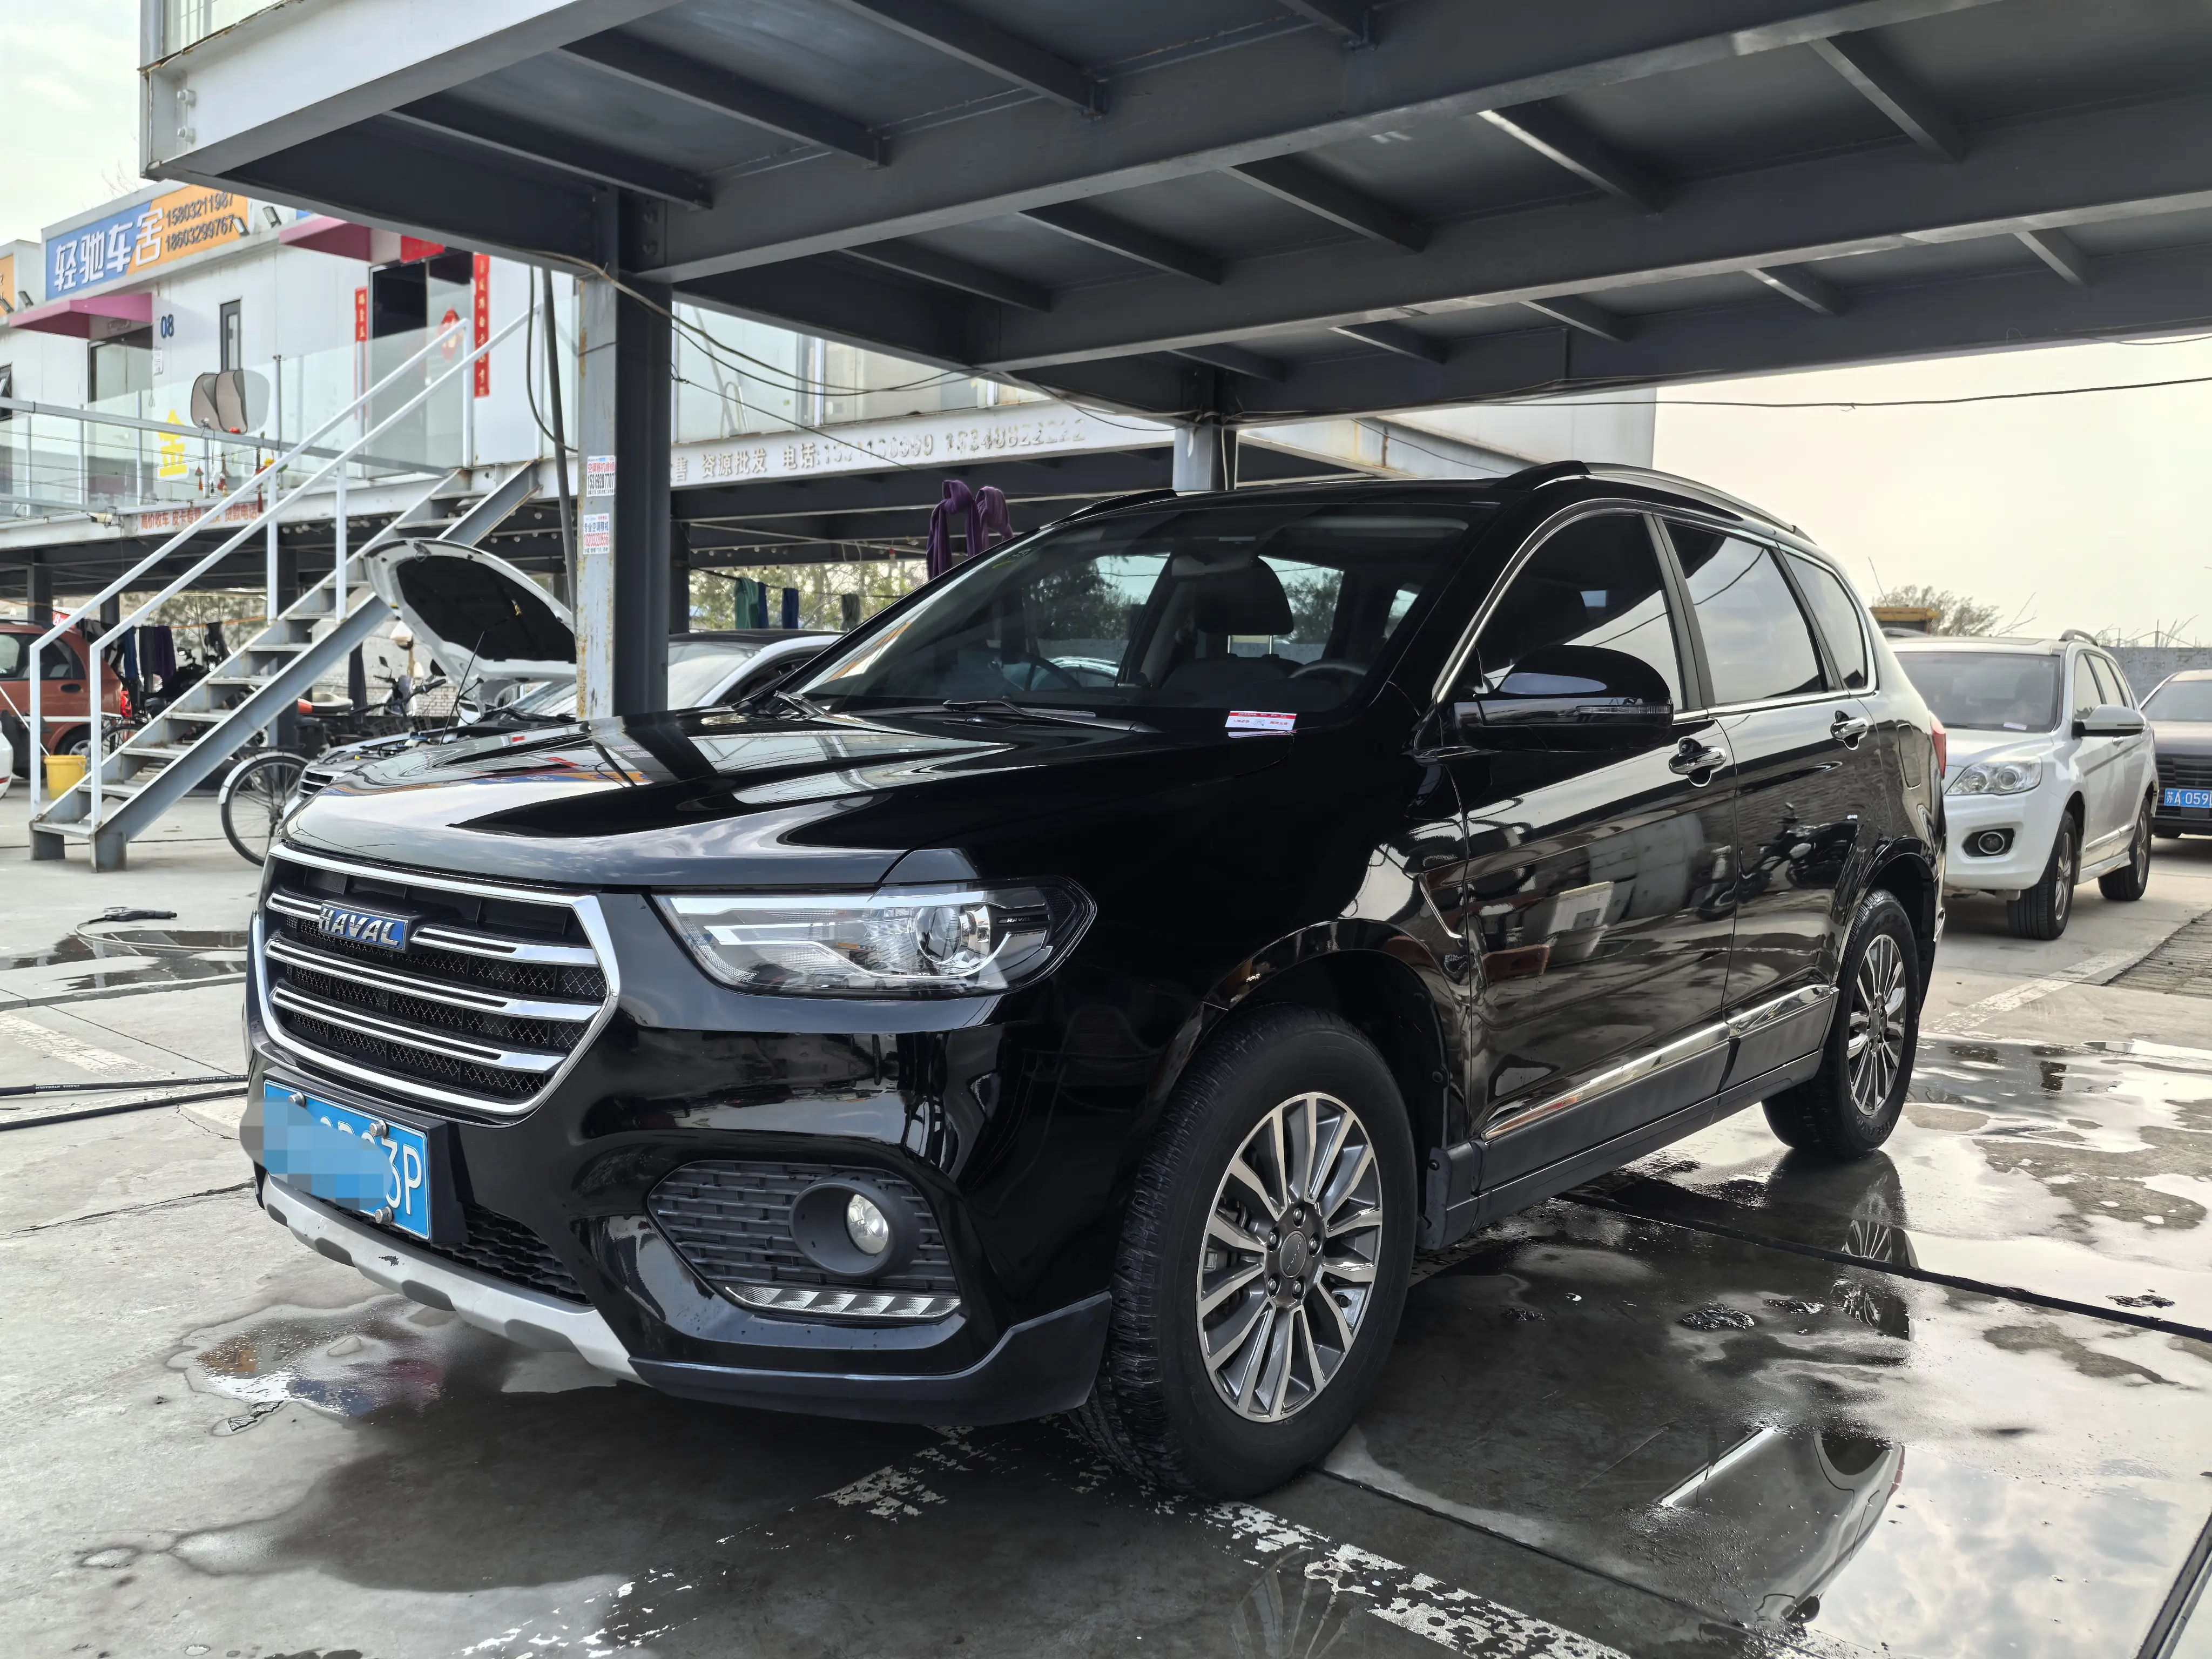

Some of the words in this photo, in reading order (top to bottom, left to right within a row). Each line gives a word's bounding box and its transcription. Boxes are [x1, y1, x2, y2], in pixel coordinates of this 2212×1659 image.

[166, 192, 233, 227] 15803211987
[54, 207, 163, 292] 轻驰车舍
[160, 314, 174, 339] 08
[702, 448, 767, 478] 资源批发
[584, 522, 609, 532] 专业空调移机
[319, 908, 400, 946] HAVAL
